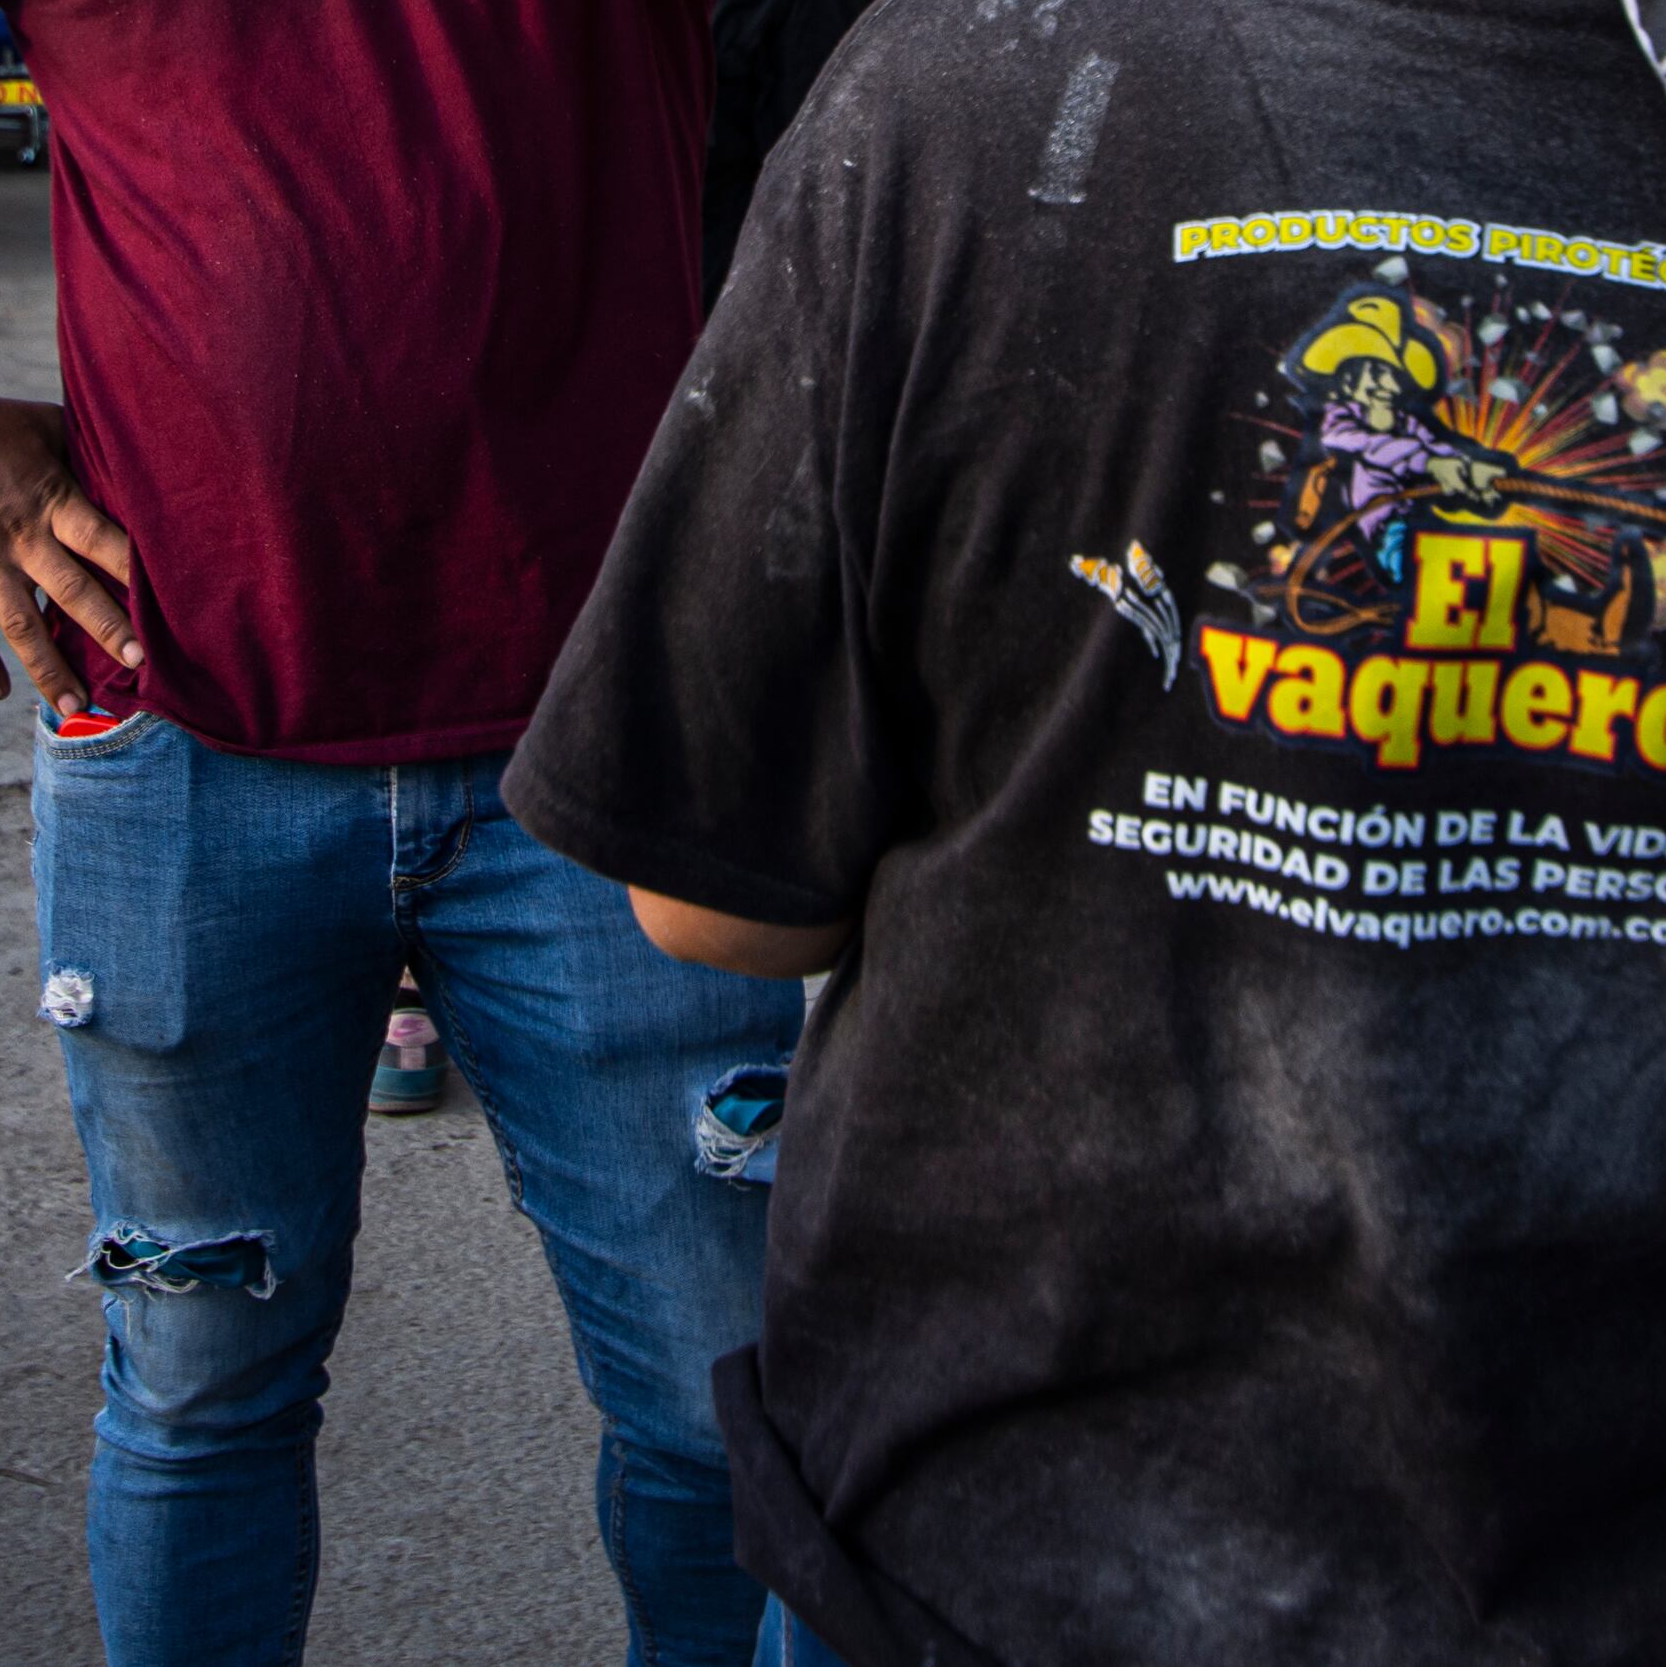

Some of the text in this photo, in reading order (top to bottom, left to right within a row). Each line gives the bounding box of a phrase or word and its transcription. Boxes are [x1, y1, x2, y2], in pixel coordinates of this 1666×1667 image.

[1175, 212, 1479, 262] PRODUCTOS
[1404, 530, 1528, 652] El
[1088, 809, 1350, 893] SEGURIDAD
[1362, 860, 1427, 897] DE
[1439, 857, 1521, 894] LAS
[1143, 771, 1208, 812] EN
[1219, 780, 1425, 849] FUNCIÓN
[1437, 811, 1496, 847] DE
[1507, 810, 1570, 852] LA
